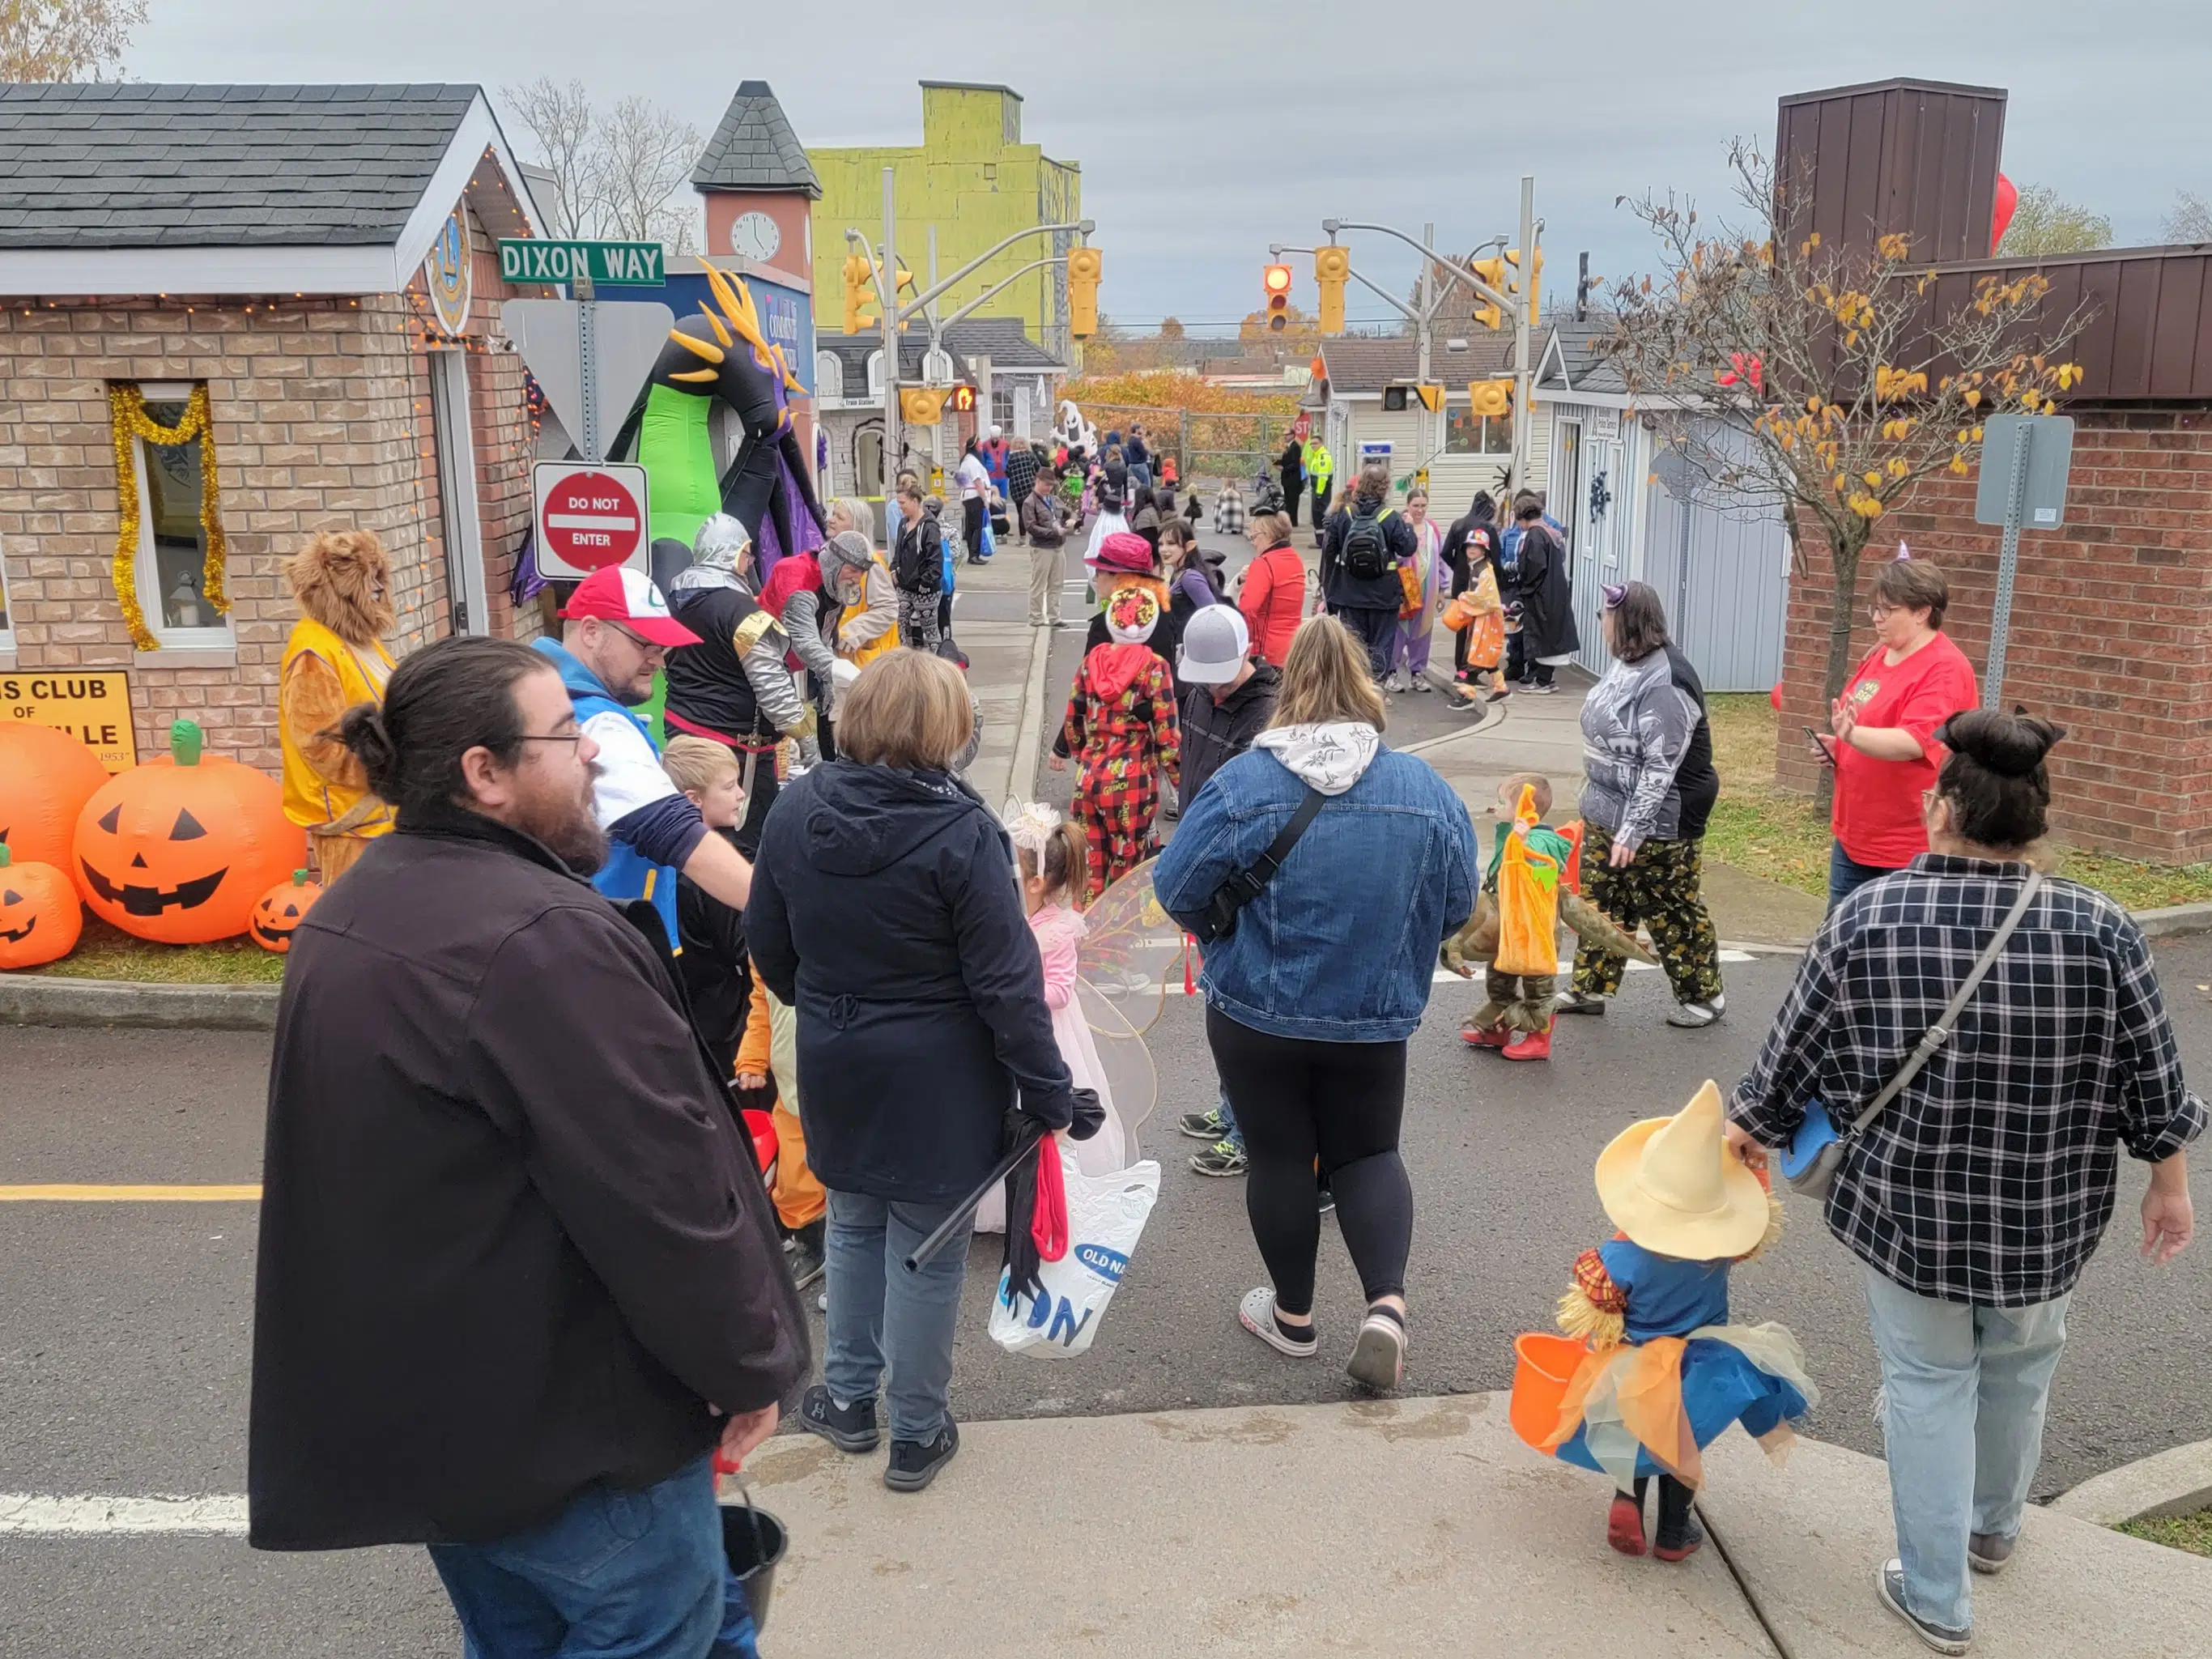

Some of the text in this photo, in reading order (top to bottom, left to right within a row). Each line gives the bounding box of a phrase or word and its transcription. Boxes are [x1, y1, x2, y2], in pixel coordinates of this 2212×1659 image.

[502, 245, 659, 279] DIXON WAY
[568, 497, 619, 511] DO NOT
[572, 533, 610, 547] ENTER
[31, 679, 107, 700] CLUB
[13, 706, 35, 718] OF
[1083, 1249, 1108, 1268] OLD
